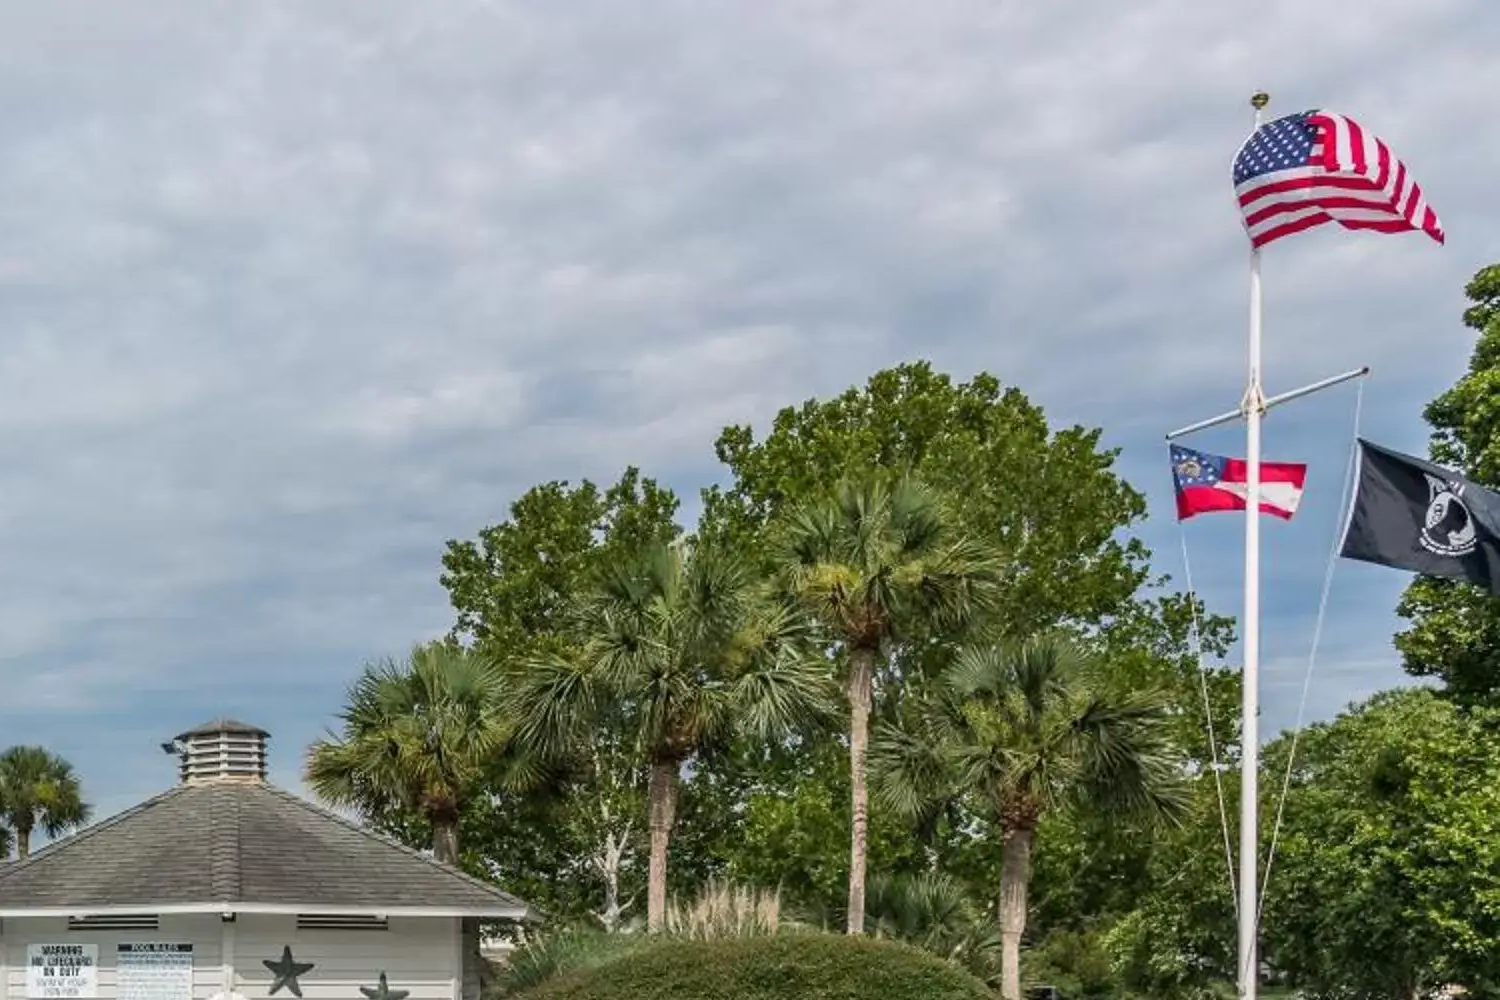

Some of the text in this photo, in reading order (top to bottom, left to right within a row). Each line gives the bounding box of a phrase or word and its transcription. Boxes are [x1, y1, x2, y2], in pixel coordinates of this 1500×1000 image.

[41, 945, 83, 955] WARNING
[31, 956, 93, 967] NO LIFEGUARD
[43, 967, 81, 977] ON DUTY
